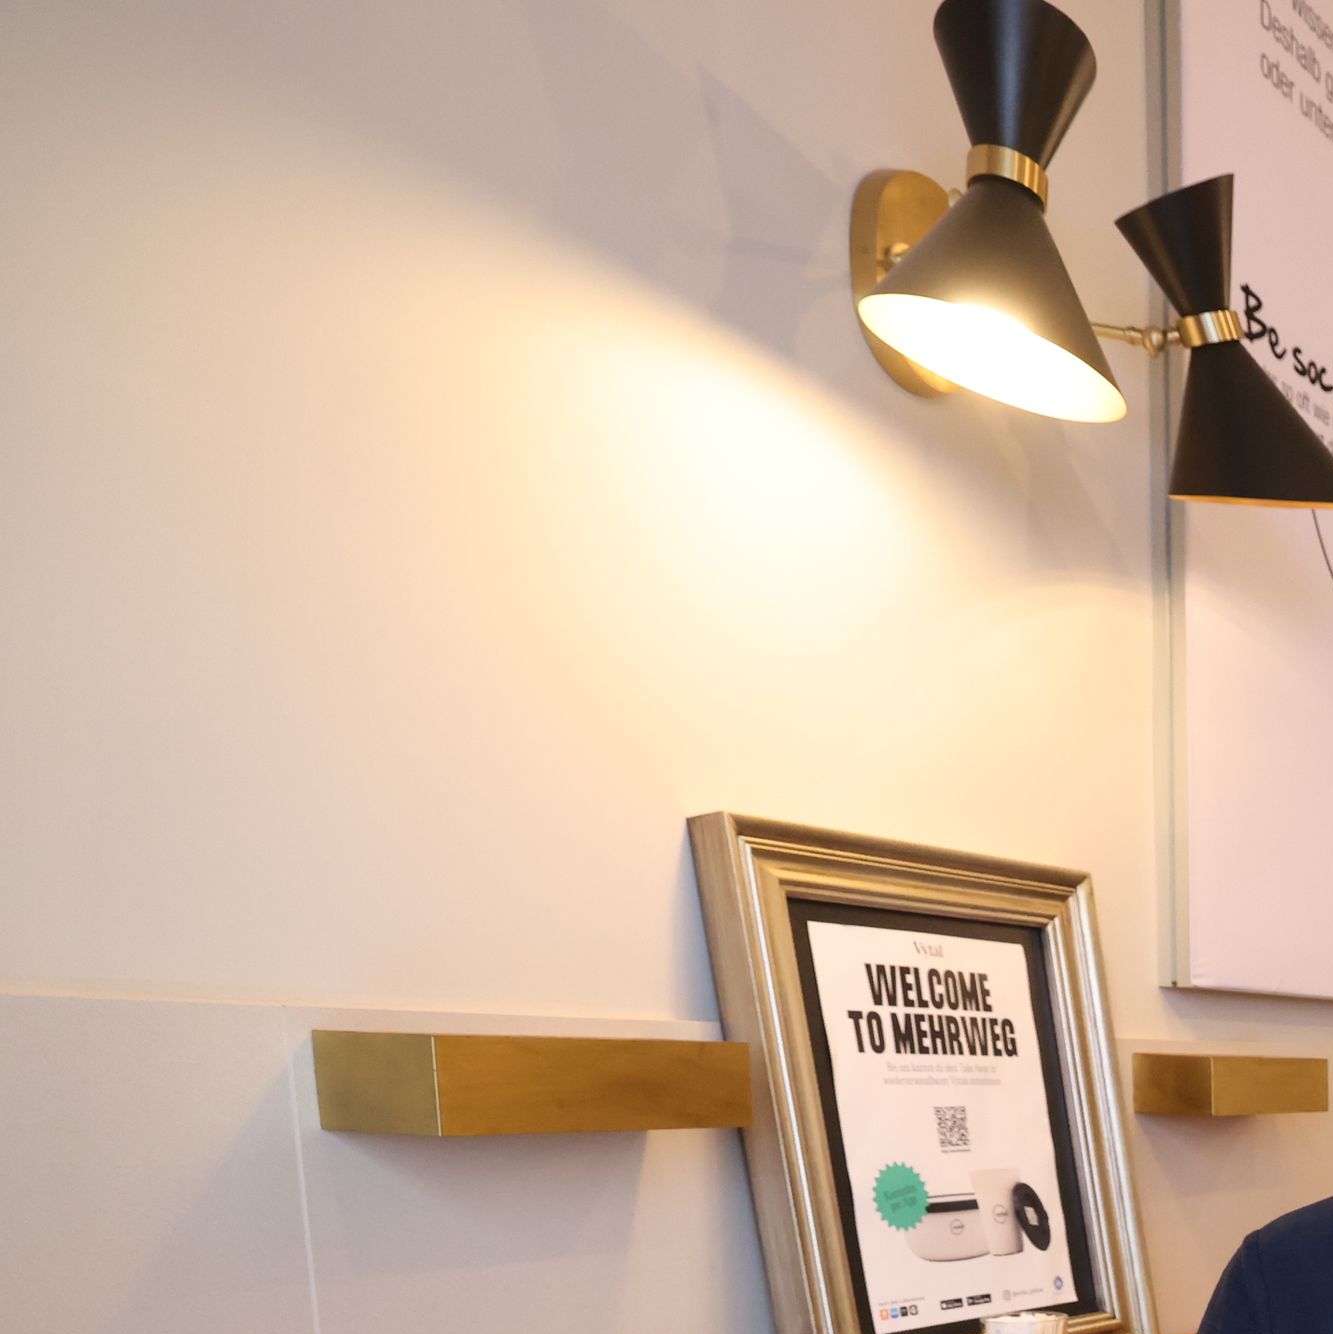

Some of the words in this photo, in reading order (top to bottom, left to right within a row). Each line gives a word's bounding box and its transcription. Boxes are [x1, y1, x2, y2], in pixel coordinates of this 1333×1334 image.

[1260, 0, 1322, 84] Deshalb
[1260, 52, 1295, 103] oder
[1240, 283, 1286, 360] Be
[864, 962, 993, 1013] WELCOME
[847, 1009, 886, 1055] TO
[889, 1011, 1019, 1058] MEHRWEG
